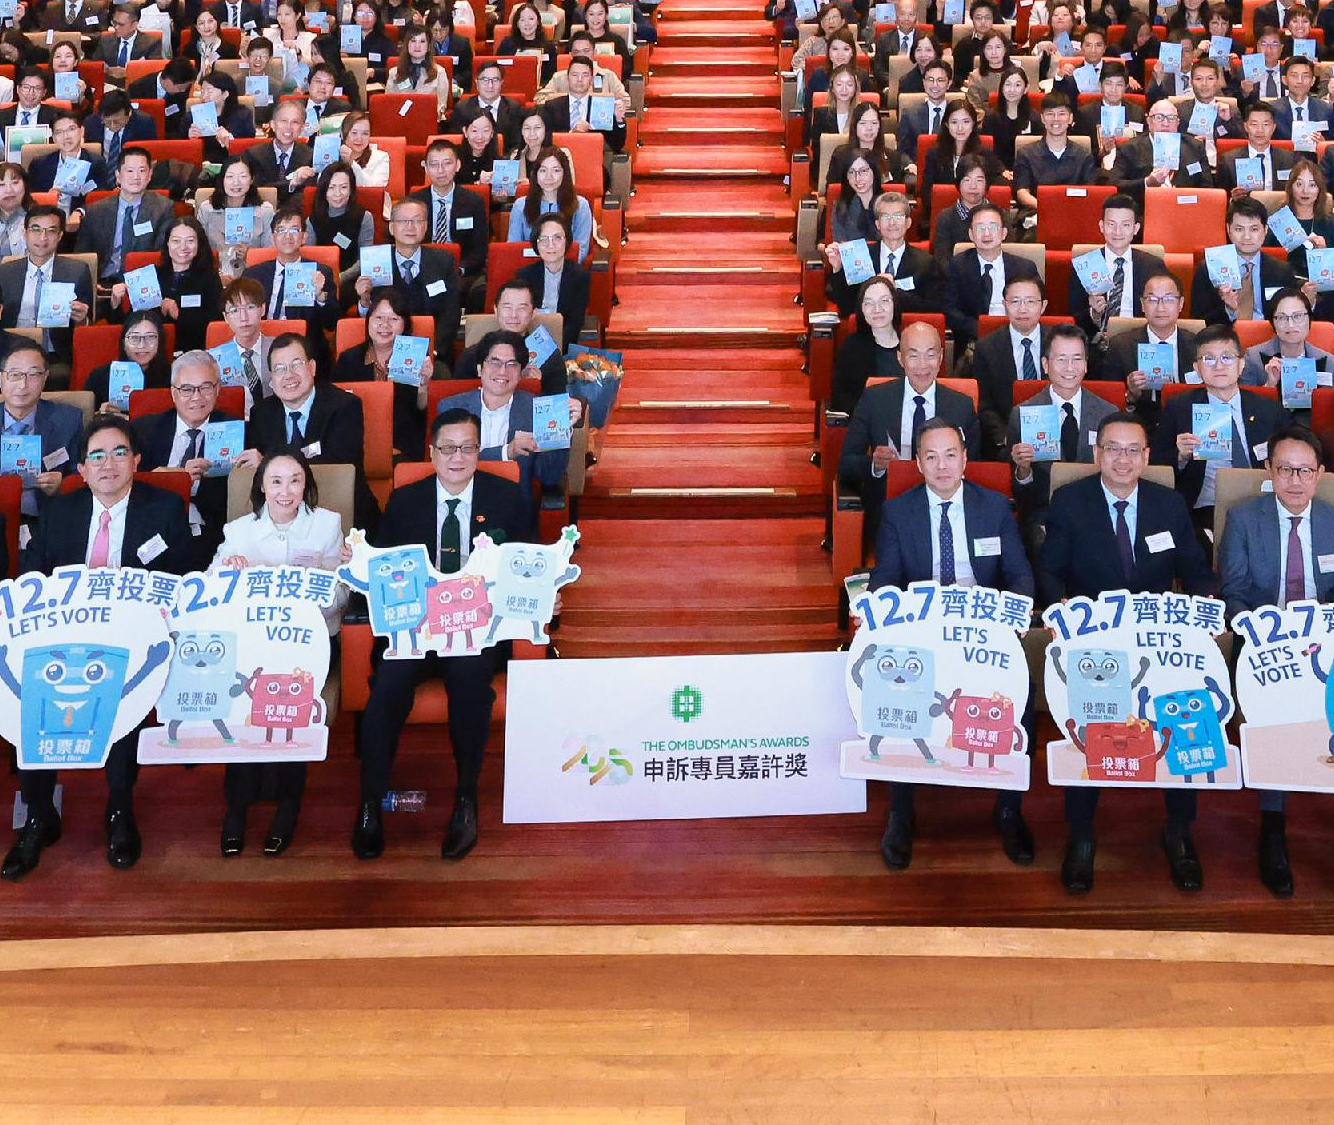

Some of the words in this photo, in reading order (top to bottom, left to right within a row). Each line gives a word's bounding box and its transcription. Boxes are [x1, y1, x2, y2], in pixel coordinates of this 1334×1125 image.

[87, 571, 178, 606] 齊投票
[171, 570, 241, 618] 2.7
[246, 570, 334, 603] 齊投票
[246, 607, 291, 622] LET'S
[856, 586, 935, 631] 12.7
[941, 590, 1029, 628] 齊投票
[9, 611, 57, 638] LET'S
[61, 607, 111, 625] VOTE
[1049, 595, 1126, 642] 12.7
[1133, 596, 1221, 630] 齊投票
[1237, 606, 1315, 648] 12.7
[266, 626, 312, 644] VOTE
[943, 627, 987, 644] LET'S
[1136, 632, 1181, 647] LET'S
[963, 647, 1010, 670] VOTE
[1157, 651, 1205, 670] VOTE
[1248, 646, 1294, 670] LET'S
[1253, 663, 1302, 687] VOTE
[177, 692, 217, 706] 投票箱
[1083, 702, 1117, 715] 投票箱
[877, 707, 917, 723] 投票箱
[38, 738, 92, 755] 投票箱
[641, 741, 665, 752] THE
[668, 738, 758, 751] OMBUDSMAN'S
[760, 736, 810, 748] AWARDS
[644, 753, 808, 782] 申訴專員嘉許獎
[1102, 757, 1139, 770] 投票箱
